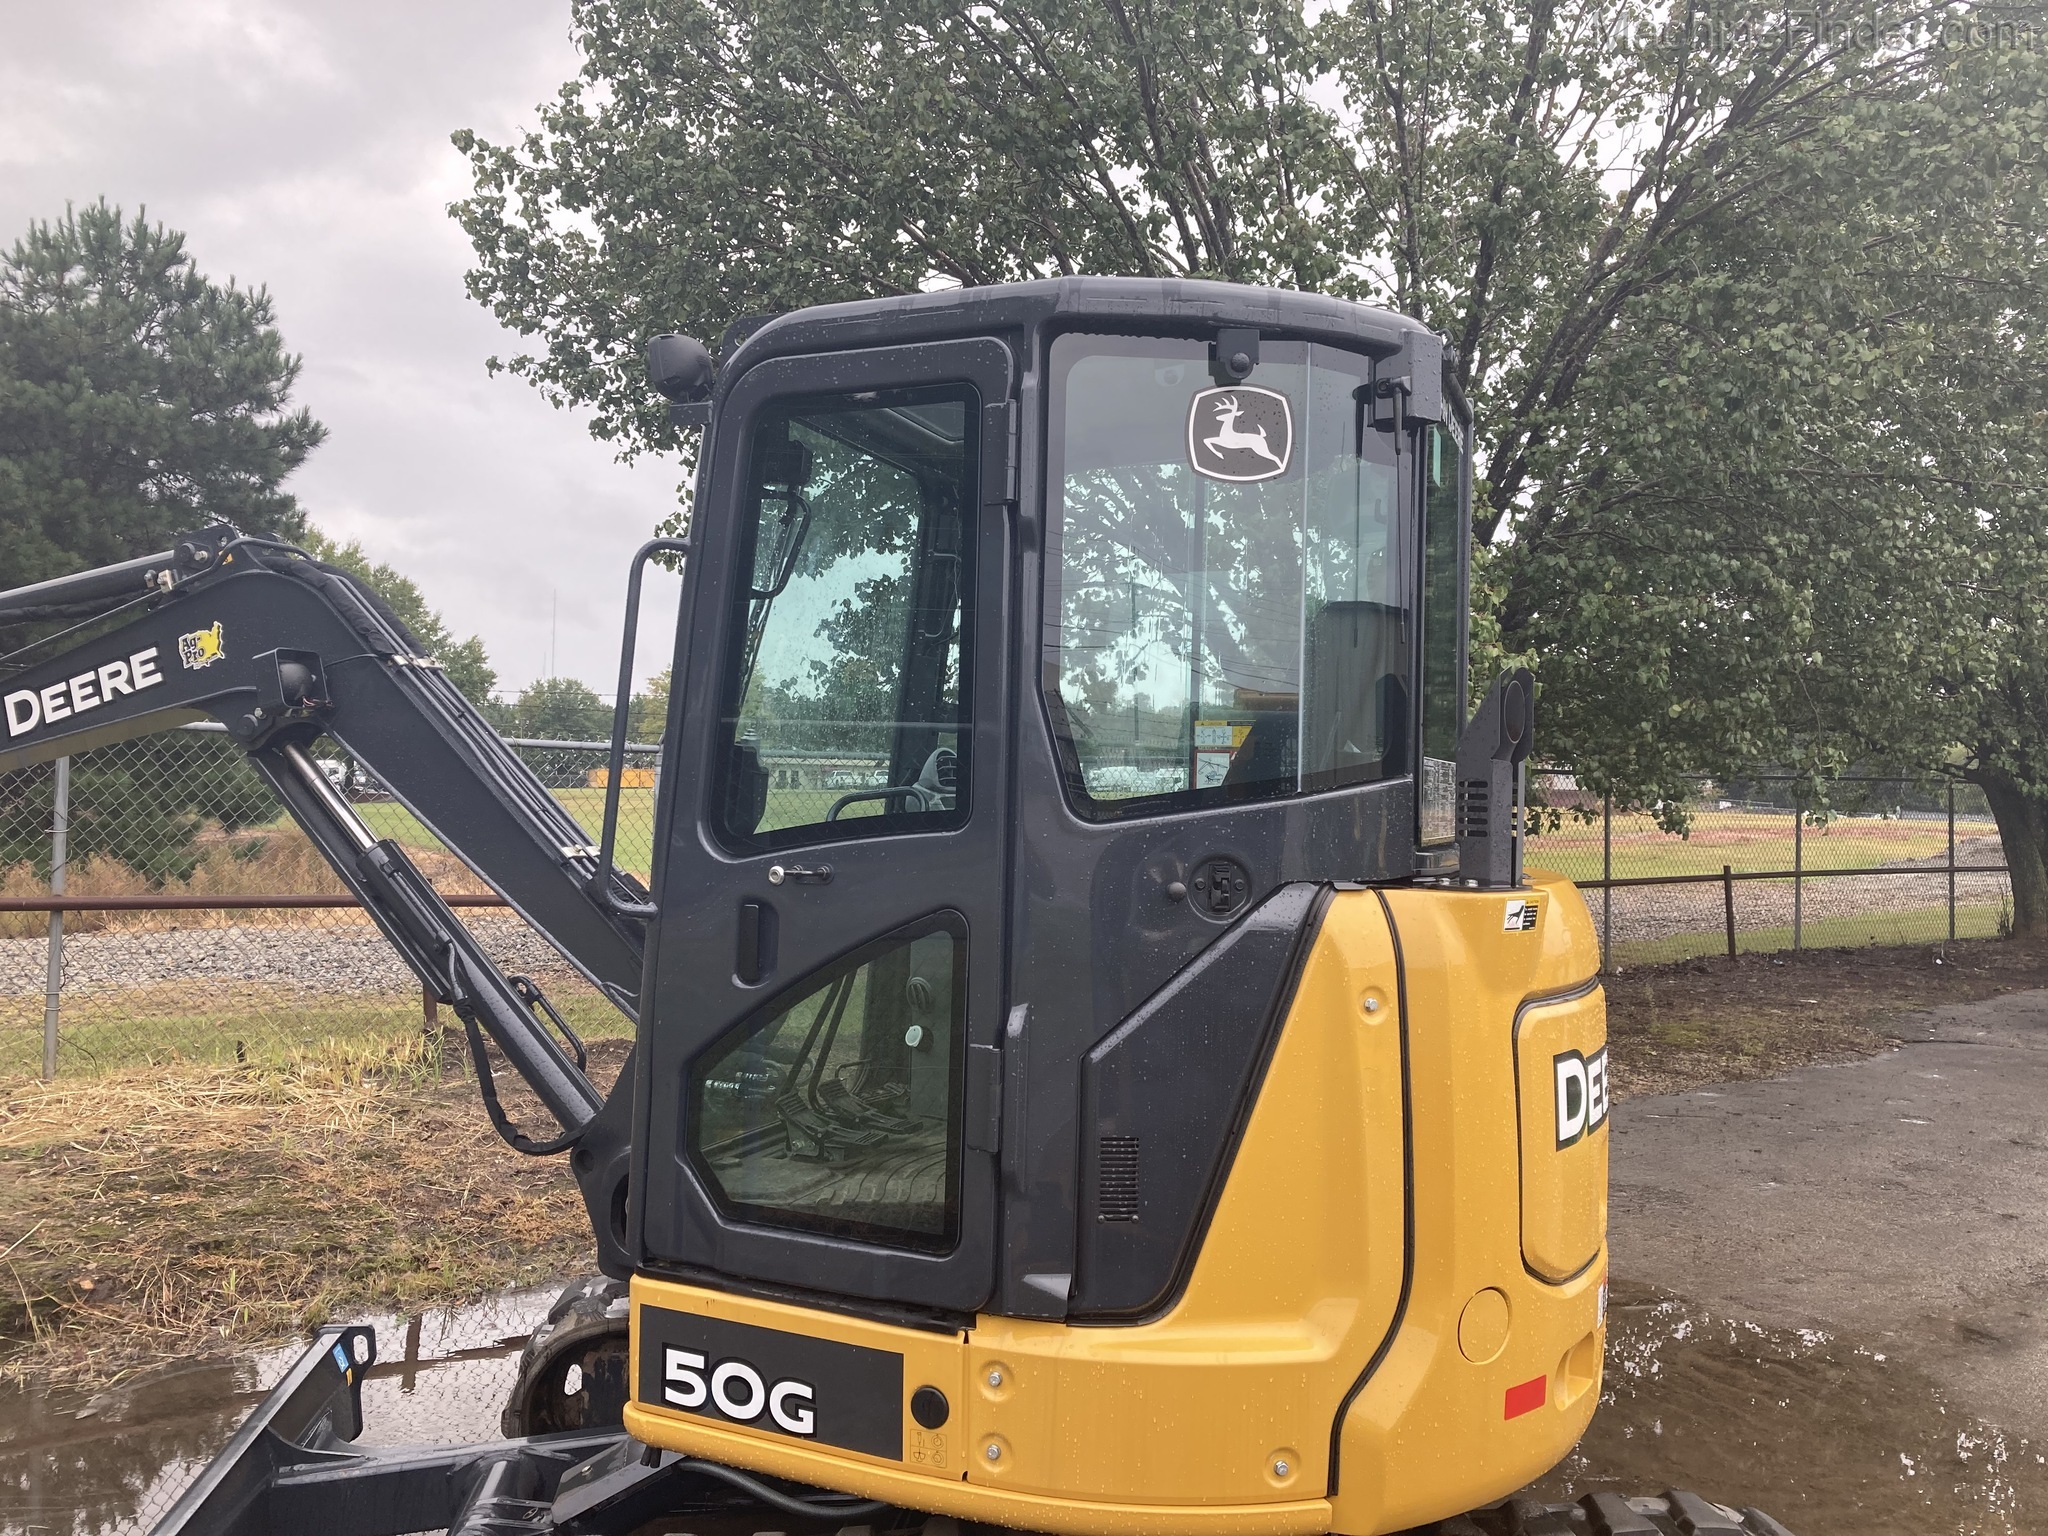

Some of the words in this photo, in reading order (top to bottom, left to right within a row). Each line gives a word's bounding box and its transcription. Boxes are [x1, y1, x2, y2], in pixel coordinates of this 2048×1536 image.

[4, 647, 163, 737] DEERE
[184, 648, 205, 665] Pro
[664, 1347, 814, 1434] 50G
